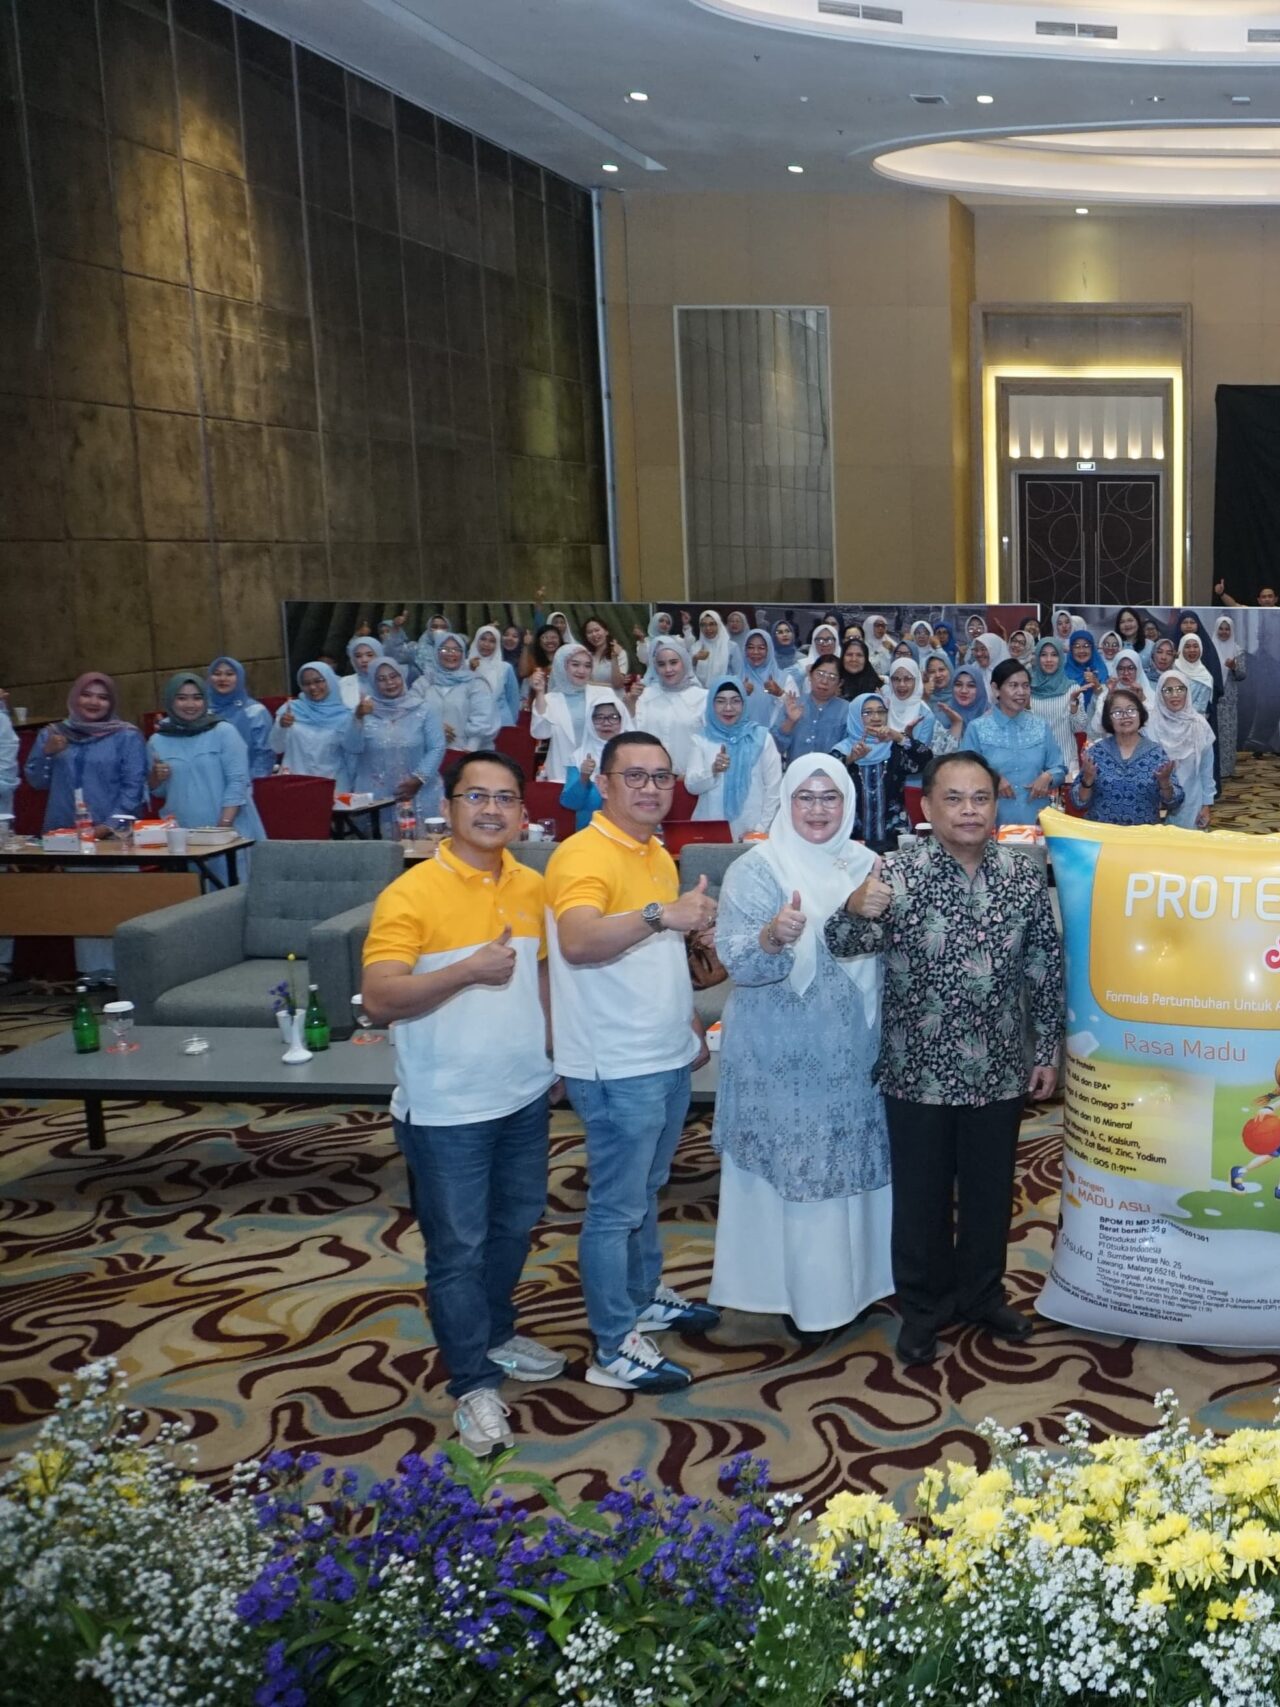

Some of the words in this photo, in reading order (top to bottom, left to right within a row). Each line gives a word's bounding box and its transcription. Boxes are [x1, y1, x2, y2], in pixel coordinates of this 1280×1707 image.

[1105, 989, 1150, 1007] Formula
[1152, 993, 1231, 1012] Pertumbuhan
[1234, 998, 1273, 1012] Untuk
[1124, 1033, 1175, 1056] Rasa
[1183, 1038, 1246, 1062] Madu
[1079, 1093, 1090, 1103] dan
[1091, 1097, 1119, 1110] Omega
[1080, 1112, 1092, 1122] dan
[1093, 1115, 1101, 1125] 10
[1102, 1118, 1133, 1130] Mineral
[1098, 1133, 1106, 1143] C,
[1107, 1135, 1141, 1149] Kalsium,
[1085, 1139, 1096, 1149] Zat
[1096, 1143, 1113, 1155] Besi,
[1115, 1148, 1134, 1160] Zinc,
[1136, 1151, 1167, 1164] Yodium
[1093, 1157, 1110, 1169] GOS
[1078, 1187, 1114, 1209] MADU
[1118, 1200, 1151, 1213] ASLI
[1099, 1216, 1123, 1226] BPOM
[1099, 1223, 1119, 1234] Berat
[1121, 1226, 1149, 1234] bersih:
[1061, 1233, 1093, 1262] Otsuka
[1098, 1233, 1137, 1244] Diproduksi
[1106, 1242, 1129, 1252] Otsuka
[1107, 1251, 1134, 1261] Sumber
[1136, 1255, 1158, 1264] Waras
[1160, 1258, 1171, 1267] No.
[1173, 1261, 1182, 1270] 25
[1127, 1263, 1153, 1274] Malang
[1179, 1272, 1214, 1286] Indonesia
[1109, 1304, 1138, 1315] TENAGA
[1140, 1310, 1184, 1323] KESEHATAN
